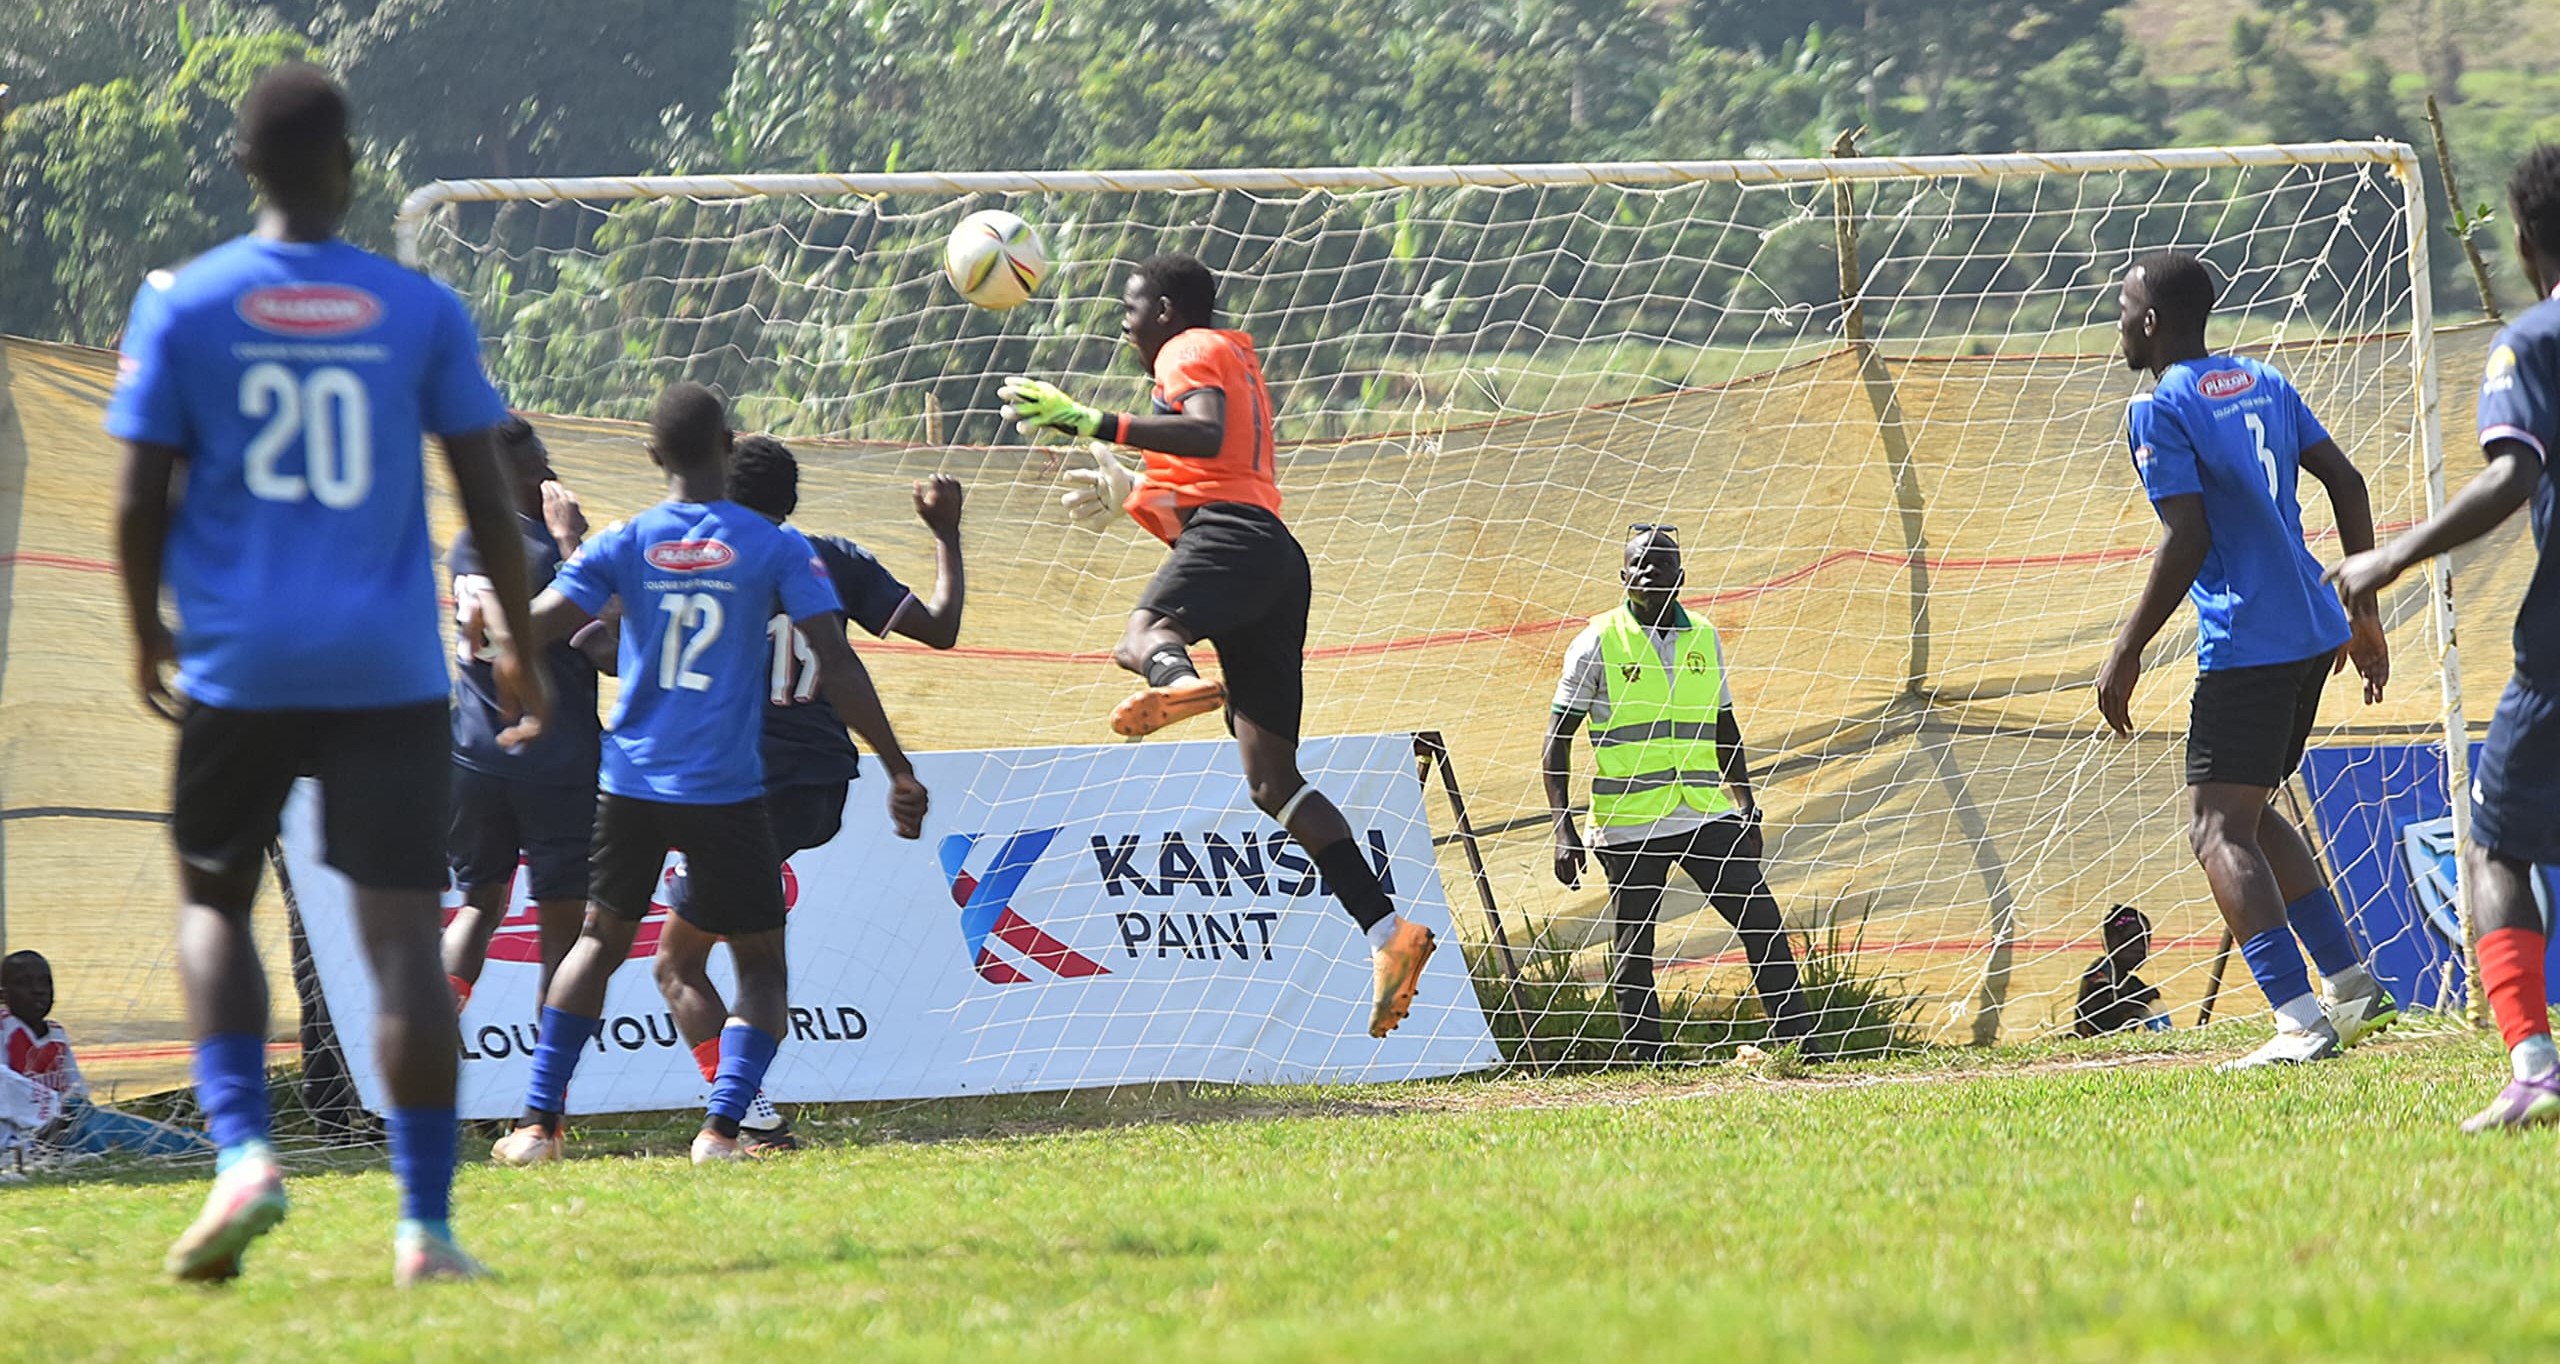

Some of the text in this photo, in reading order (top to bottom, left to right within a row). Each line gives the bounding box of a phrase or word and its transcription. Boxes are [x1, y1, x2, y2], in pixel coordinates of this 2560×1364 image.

[238, 362, 372, 510] 20
[658, 593, 724, 692] 12
[1091, 829, 1396, 897] KANSI
[1116, 911, 1278, 961] PAINT
